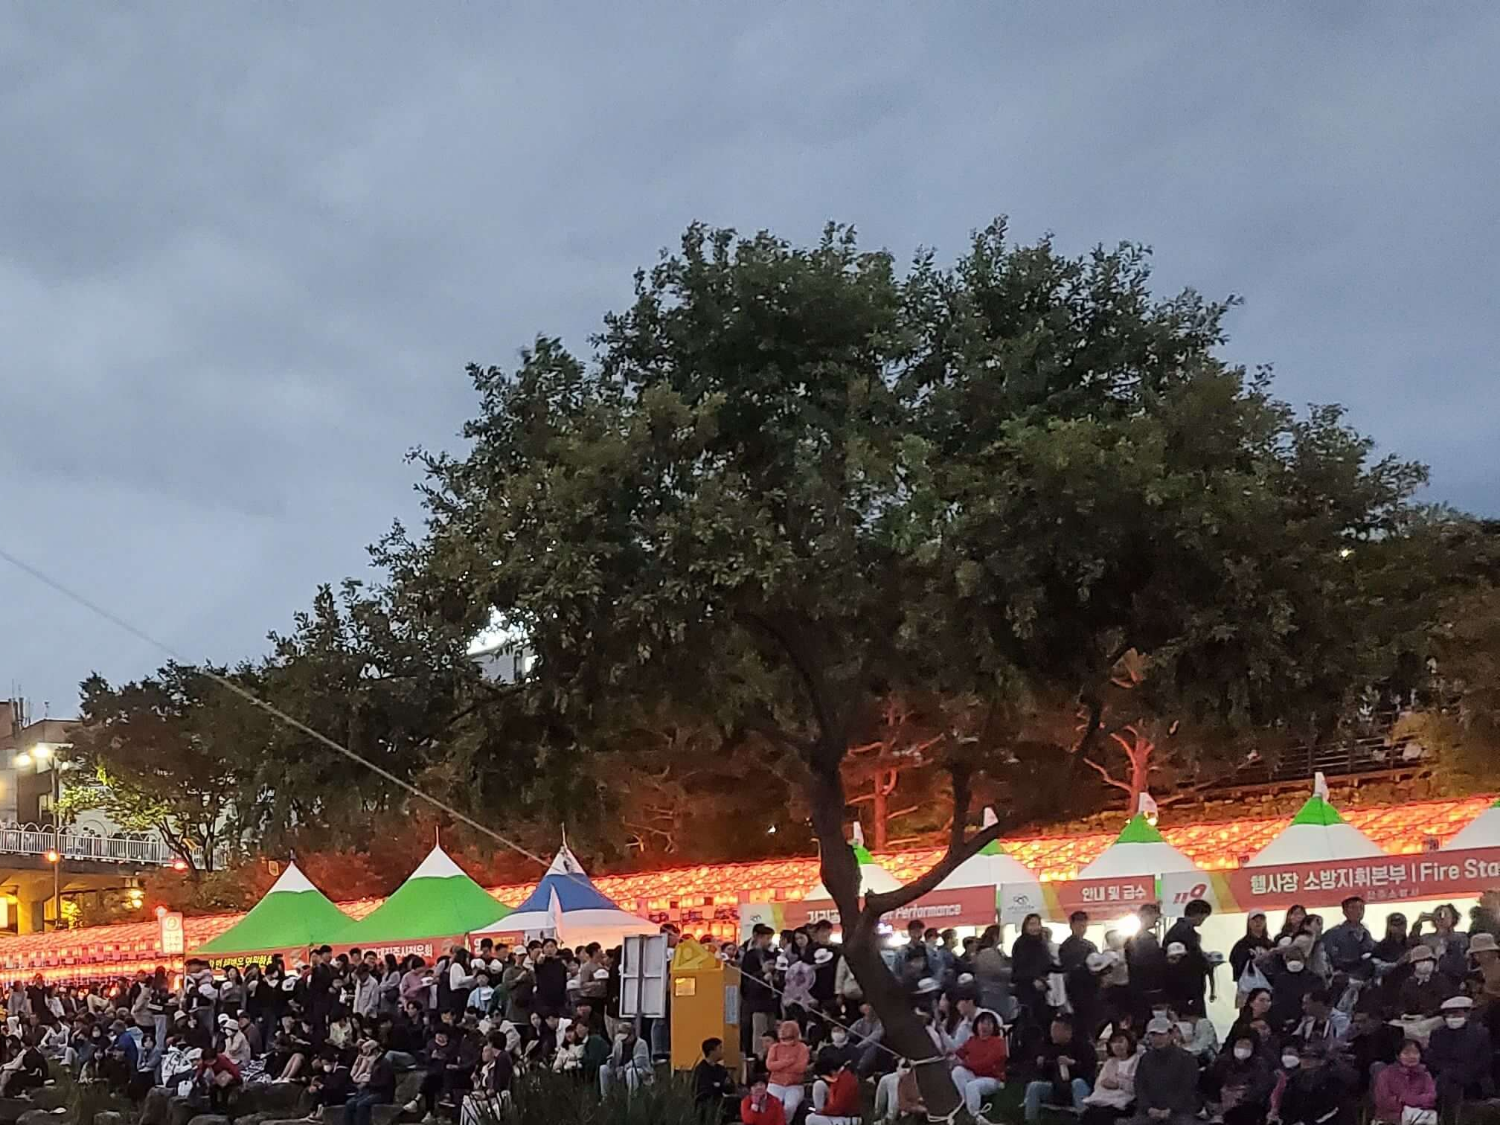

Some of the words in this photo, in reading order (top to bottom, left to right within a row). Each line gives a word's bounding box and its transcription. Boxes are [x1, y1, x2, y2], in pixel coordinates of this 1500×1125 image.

[1251, 872, 1299, 895] 행사장
[1303, 865, 1407, 891] 소방지휘본부
[1420, 862, 1460, 881] Fire
[1082, 886, 1106, 902] 안내
[1108, 885, 1120, 901] 및
[1122, 883, 1147, 900] 급수
